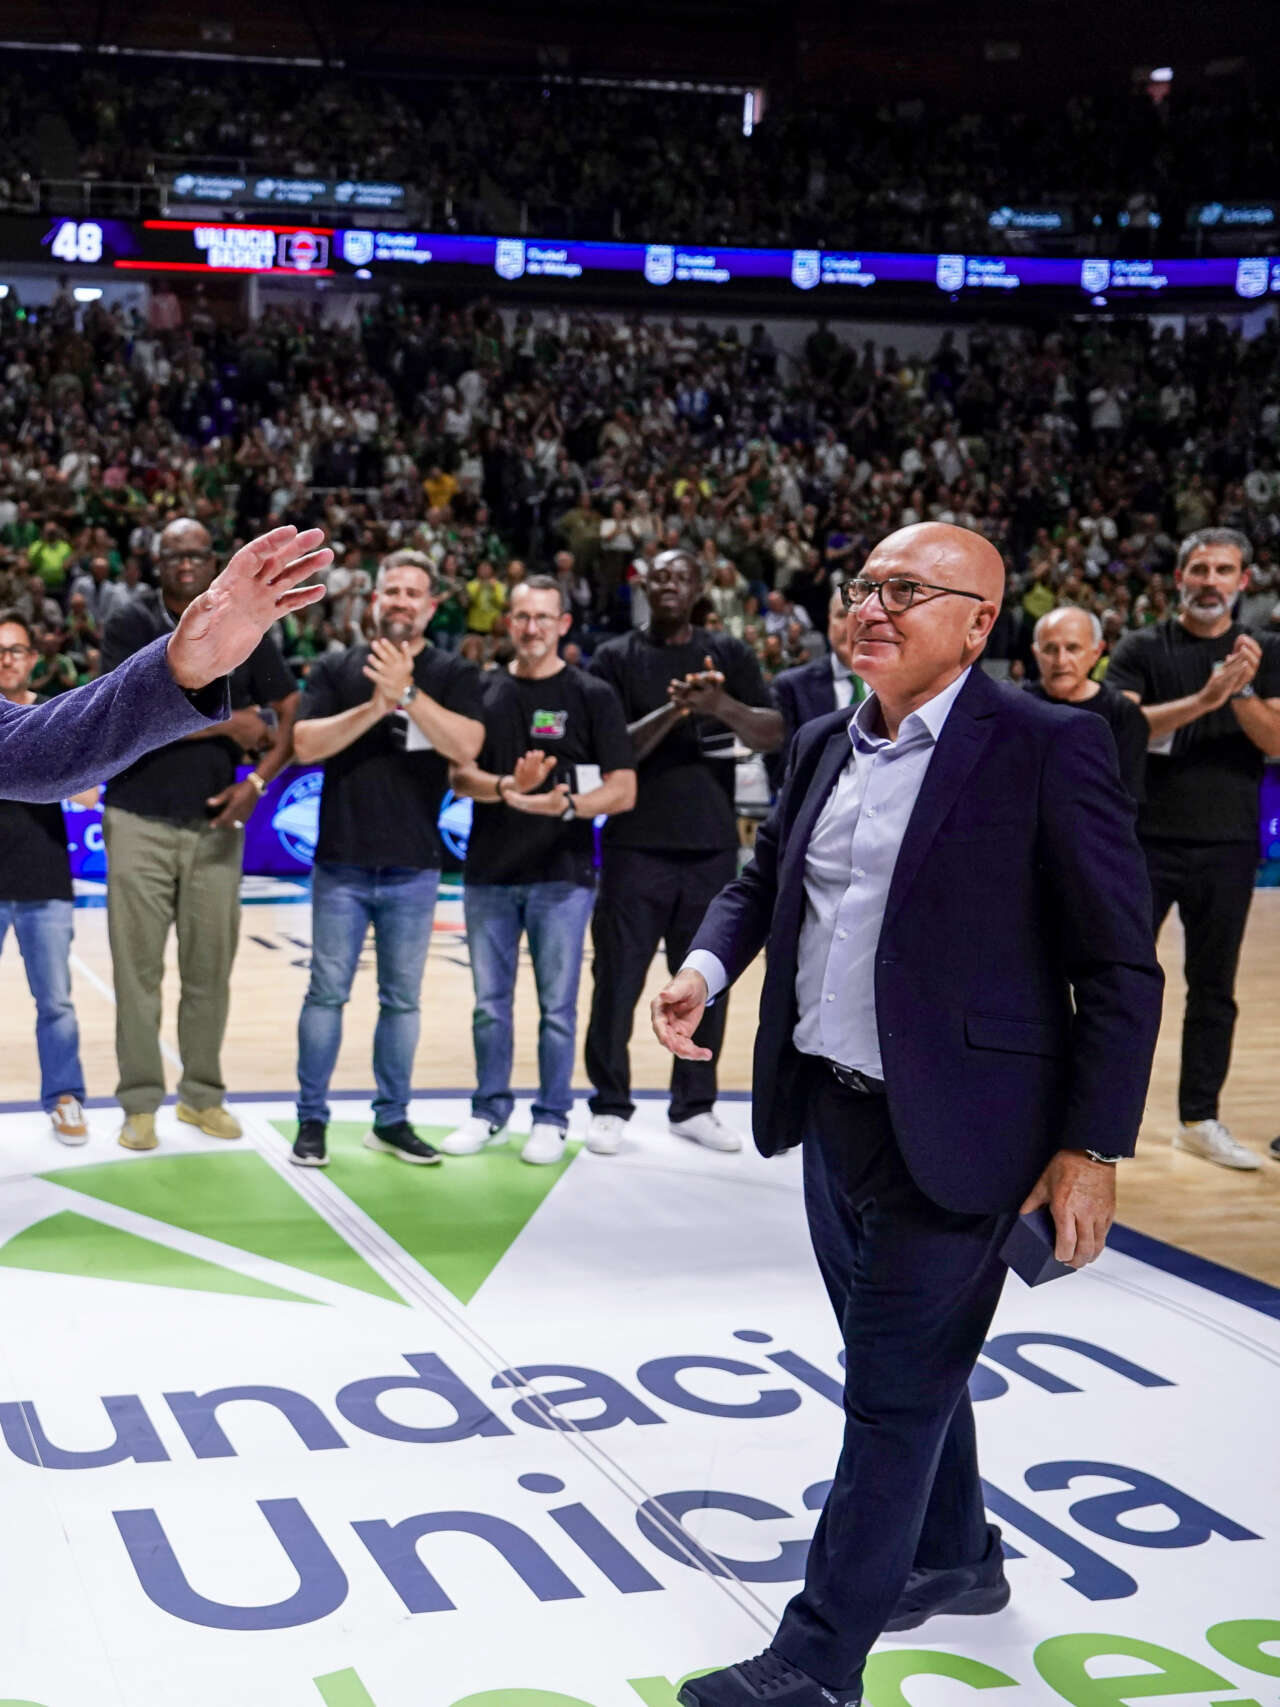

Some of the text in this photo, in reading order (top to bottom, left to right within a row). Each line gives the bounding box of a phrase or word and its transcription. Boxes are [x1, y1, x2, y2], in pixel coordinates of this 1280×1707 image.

[51, 222, 103, 262] 48
[194, 227, 275, 250] VALENCIA
[207, 247, 274, 269] BASKET
[111, 1460, 1265, 1631] Unicja
